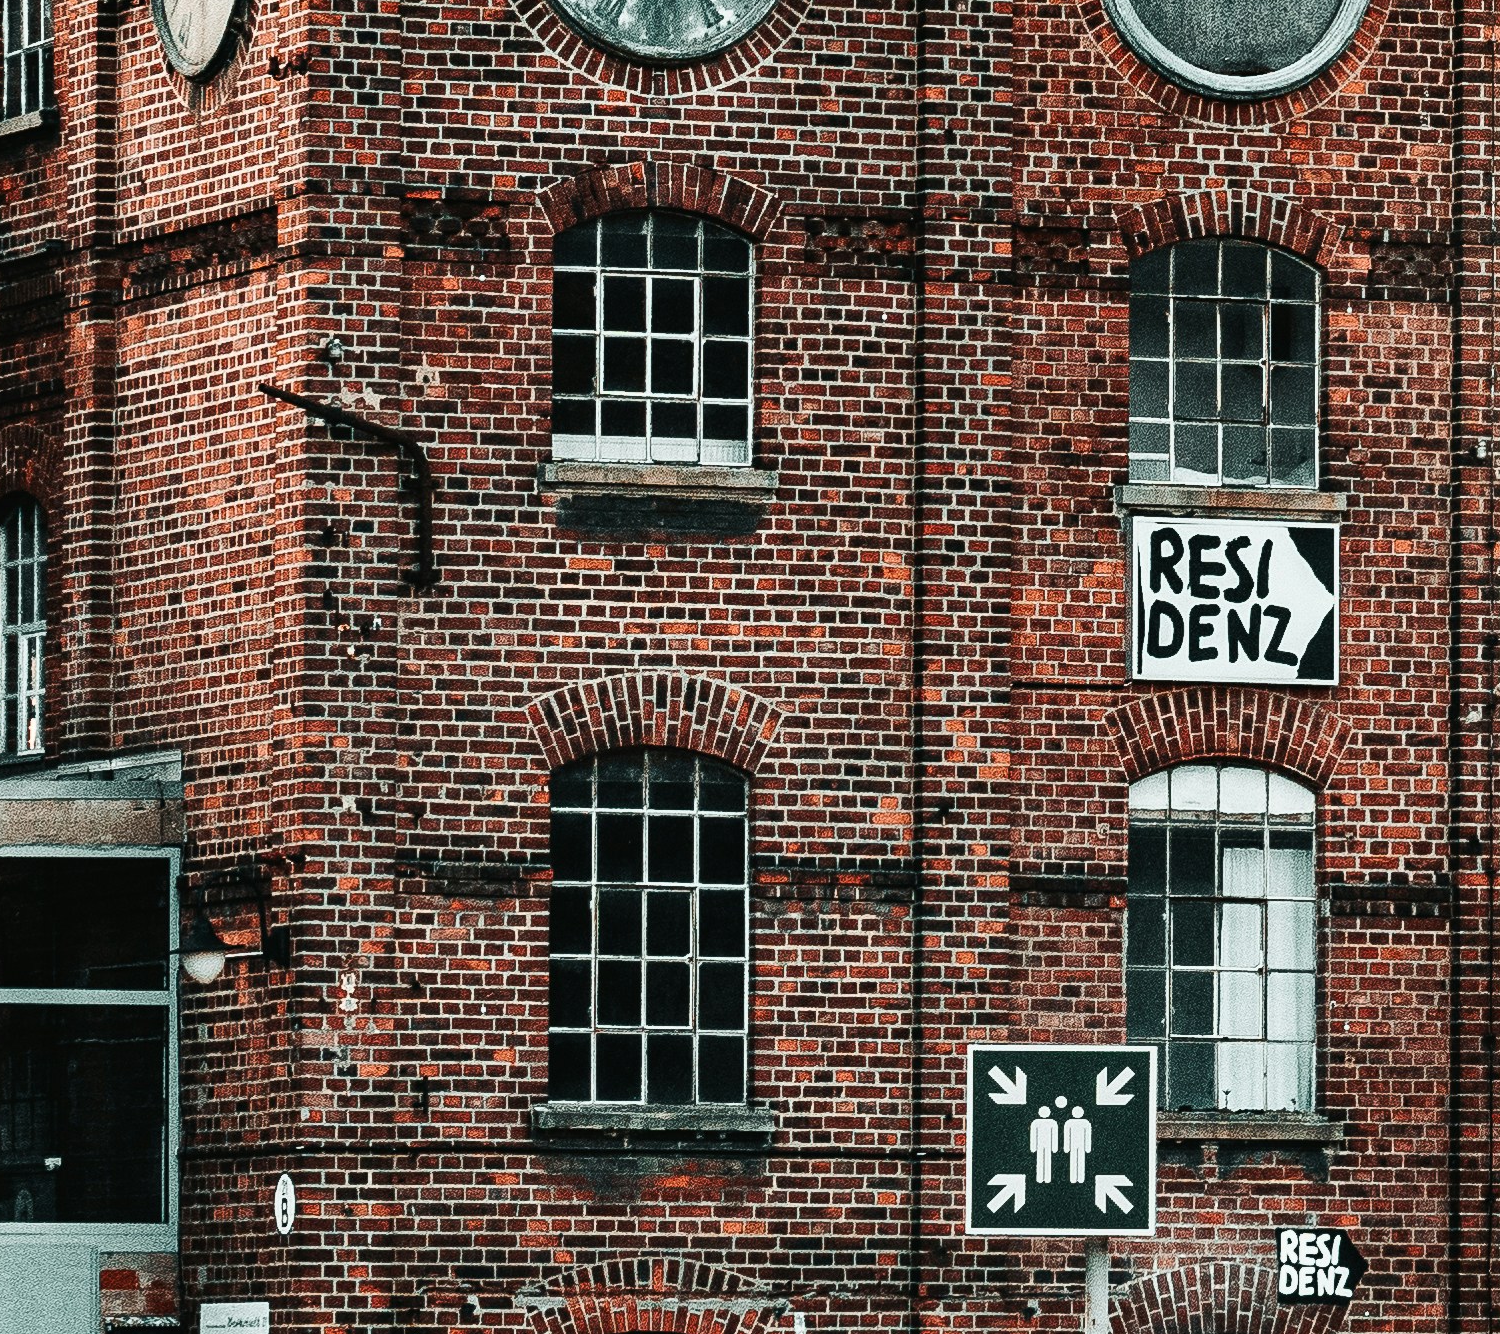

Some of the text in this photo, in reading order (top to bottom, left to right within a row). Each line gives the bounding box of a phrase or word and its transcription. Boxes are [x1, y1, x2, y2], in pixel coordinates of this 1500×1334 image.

[1150, 527, 1273, 603] RESI
[1147, 599, 1298, 666] DENZ
[281, 1197, 289, 1228] B
[1280, 1229, 1341, 1267] RESI
[1279, 1264, 1352, 1297] DENZ
